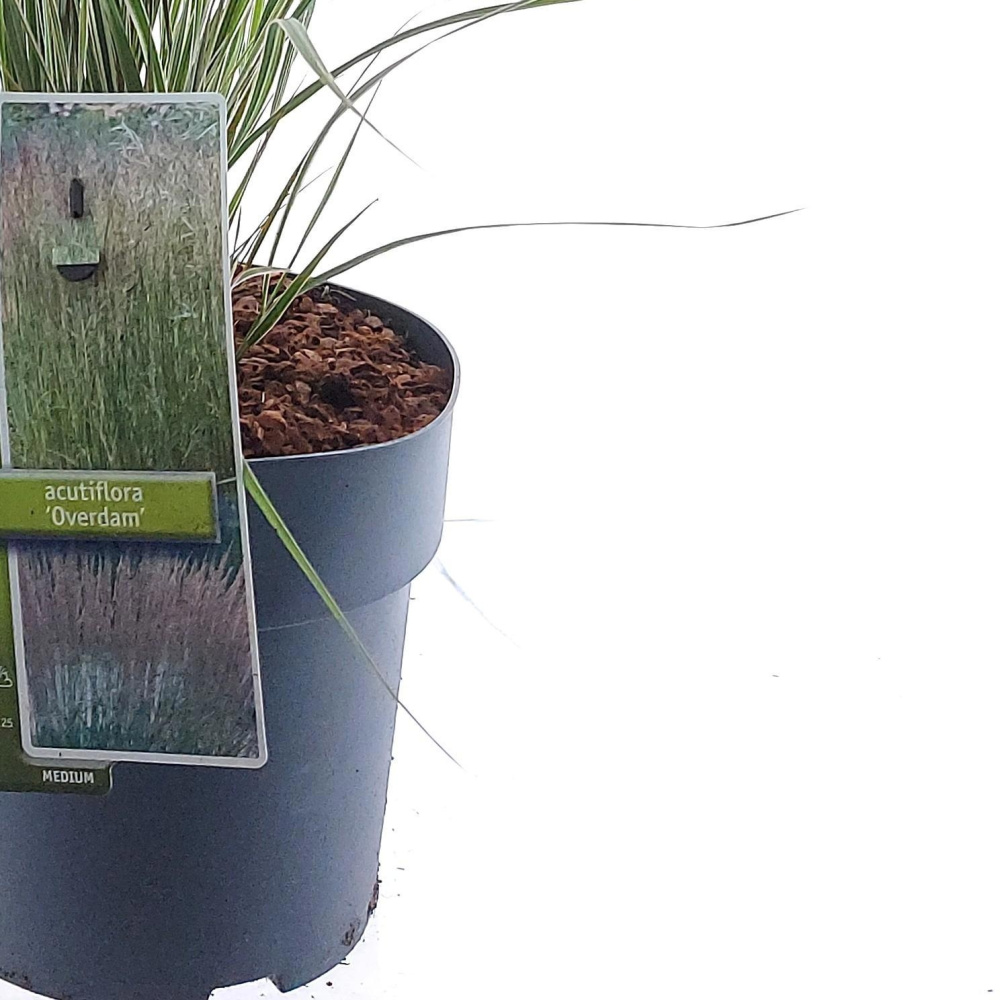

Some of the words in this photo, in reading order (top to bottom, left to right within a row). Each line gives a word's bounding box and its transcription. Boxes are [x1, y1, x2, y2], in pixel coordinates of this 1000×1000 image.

[45, 481, 143, 502] acutiflora
[46, 507, 145, 528] 'Overdam'
[43, 770, 95, 784] MEDIUM
